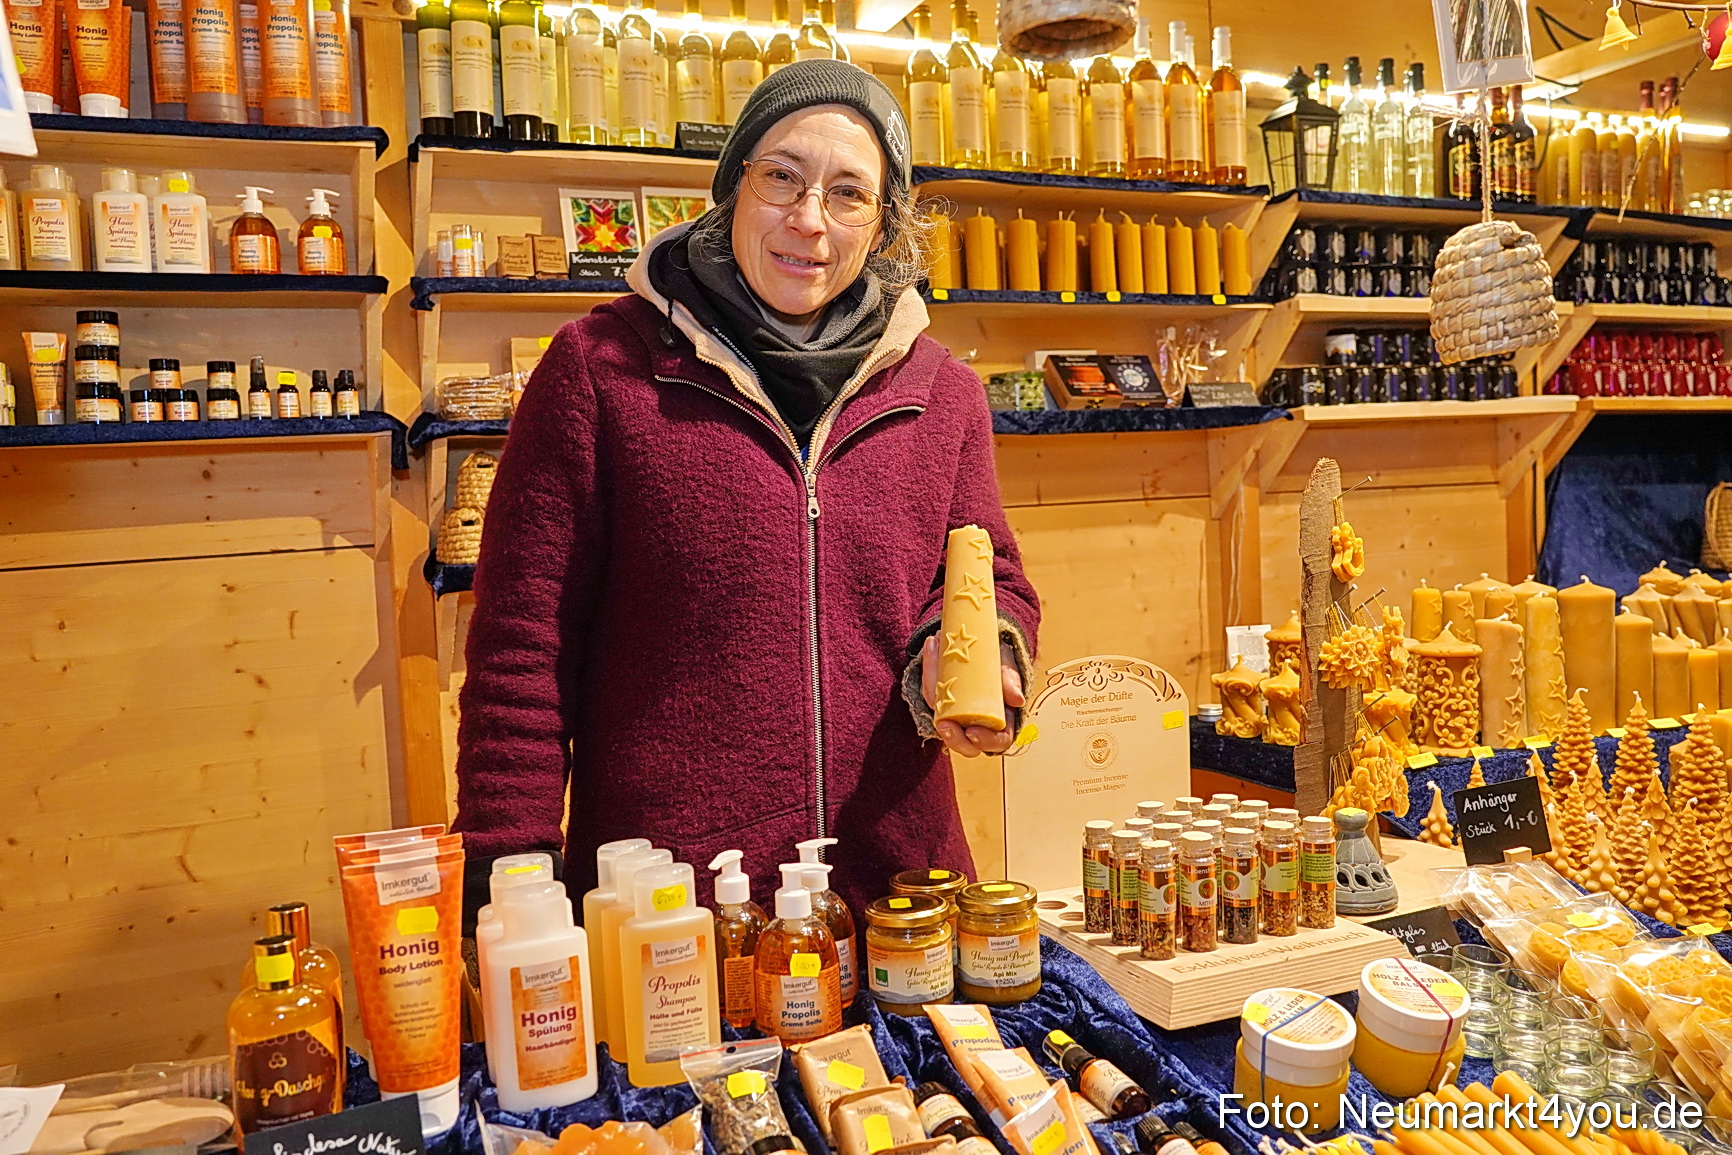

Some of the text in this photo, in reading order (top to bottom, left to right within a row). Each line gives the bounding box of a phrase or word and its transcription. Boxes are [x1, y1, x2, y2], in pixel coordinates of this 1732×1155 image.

[196, 8, 223, 18] Honig
[271, 15, 297, 24] Honig
[10, 22, 42, 32] Honig
[191, 18, 229, 27] Propolis
[267, 24, 302, 33] Propolis
[76, 25, 108, 36] Honig
[32, 216, 64, 227] Propolis
[1060, 690, 1134, 708] Magie der Düfte
[1060, 713, 1137, 730] Die Kraft der Bäume
[1072, 774, 1129, 787] Premium Incense
[1076, 782, 1126, 796] Incenso Magico
[1463, 792, 1518, 814] Anhänger
[1465, 821, 1497, 838] Stück
[381, 872, 430, 891] Imkergut
[379, 938, 440, 960] Honig
[655, 943, 691, 958] Imkergut
[970, 950, 996, 964] Honig
[1009, 949, 1035, 961] Propolis
[379, 959, 444, 975] Body Lotion
[905, 965, 931, 980] Honig
[525, 968, 563, 984] Imkergut
[648, 973, 702, 994] Propolis
[1372, 972, 1401, 981] HOLZ
[783, 980, 812, 989] Imkergut
[656, 994, 697, 1010] Shampoo
[786, 1000, 815, 1011] Honig
[1283, 993, 1308, 1012] LEDER
[520, 1005, 578, 1029] Honig
[649, 1006, 703, 1021] Hülle und Fülle
[782, 1010, 821, 1020] Propolis
[528, 1022, 573, 1039] Spülung
[781, 1018, 823, 1028] Creme Seife
[525, 1036, 577, 1052] Haarbändiger
